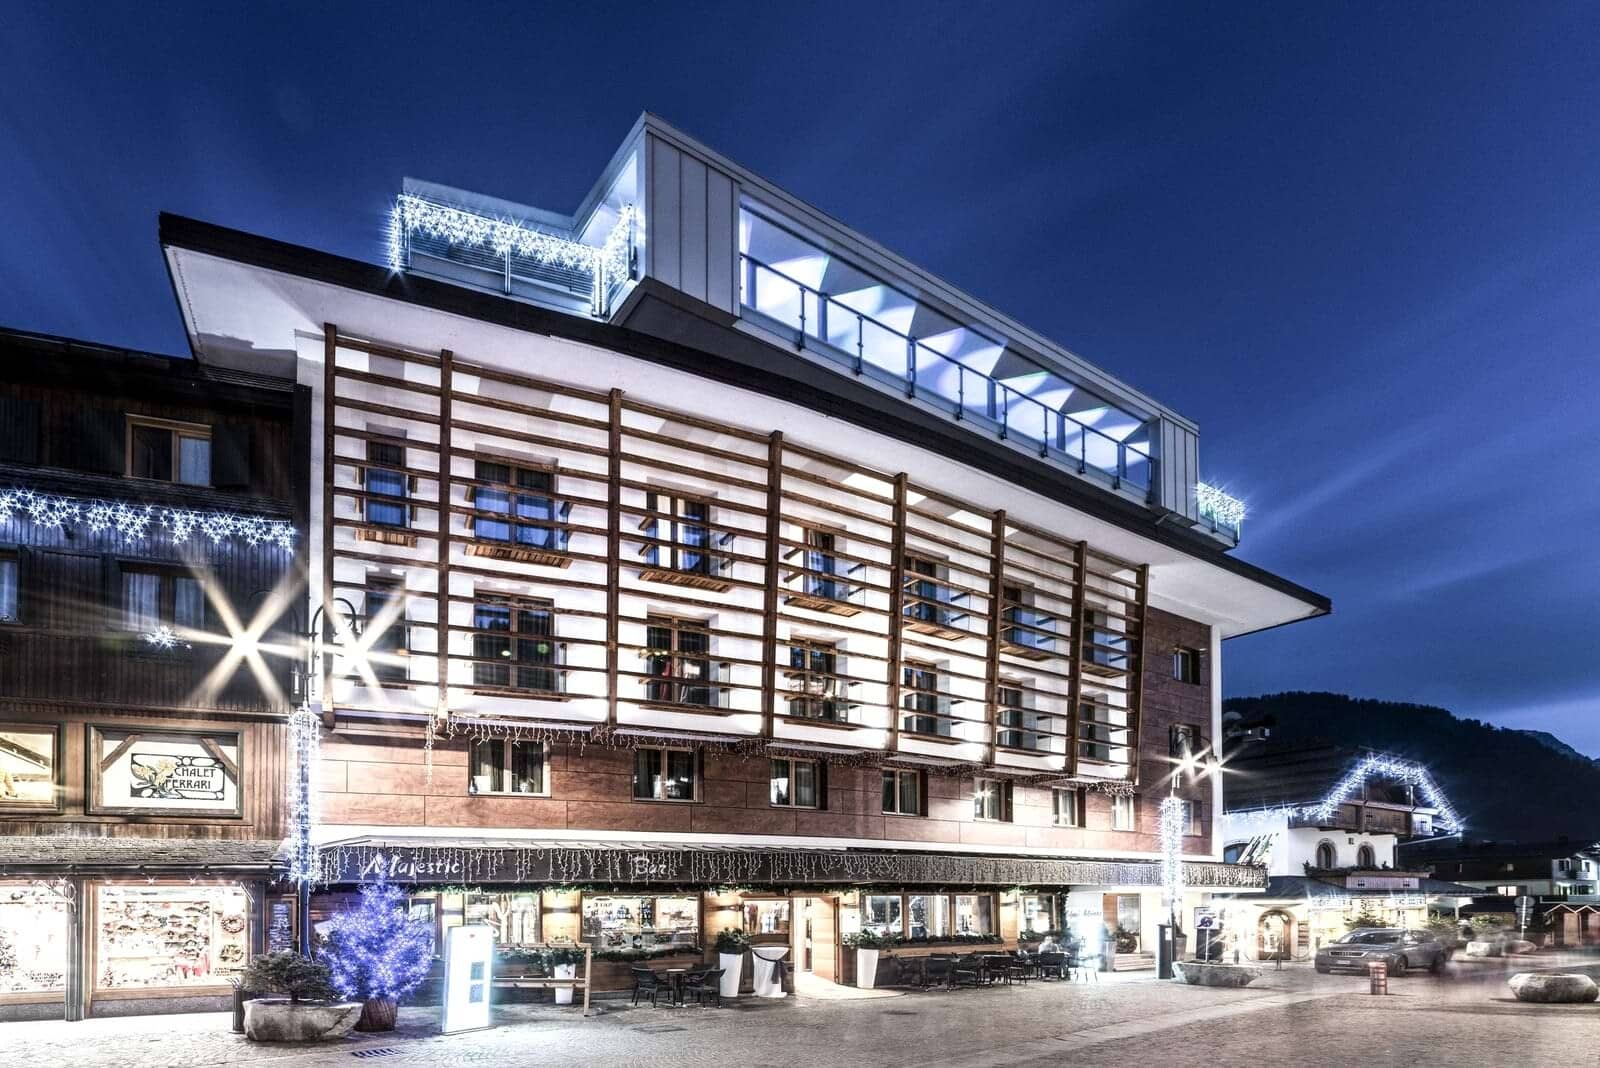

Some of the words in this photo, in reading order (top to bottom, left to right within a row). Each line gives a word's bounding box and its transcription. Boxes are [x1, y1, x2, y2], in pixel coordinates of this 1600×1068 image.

[174, 767, 216, 778] CHALET
[165, 779, 211, 790] FERRARI
[361, 855, 460, 878] Majestic
[632, 855, 667, 875] Bar
